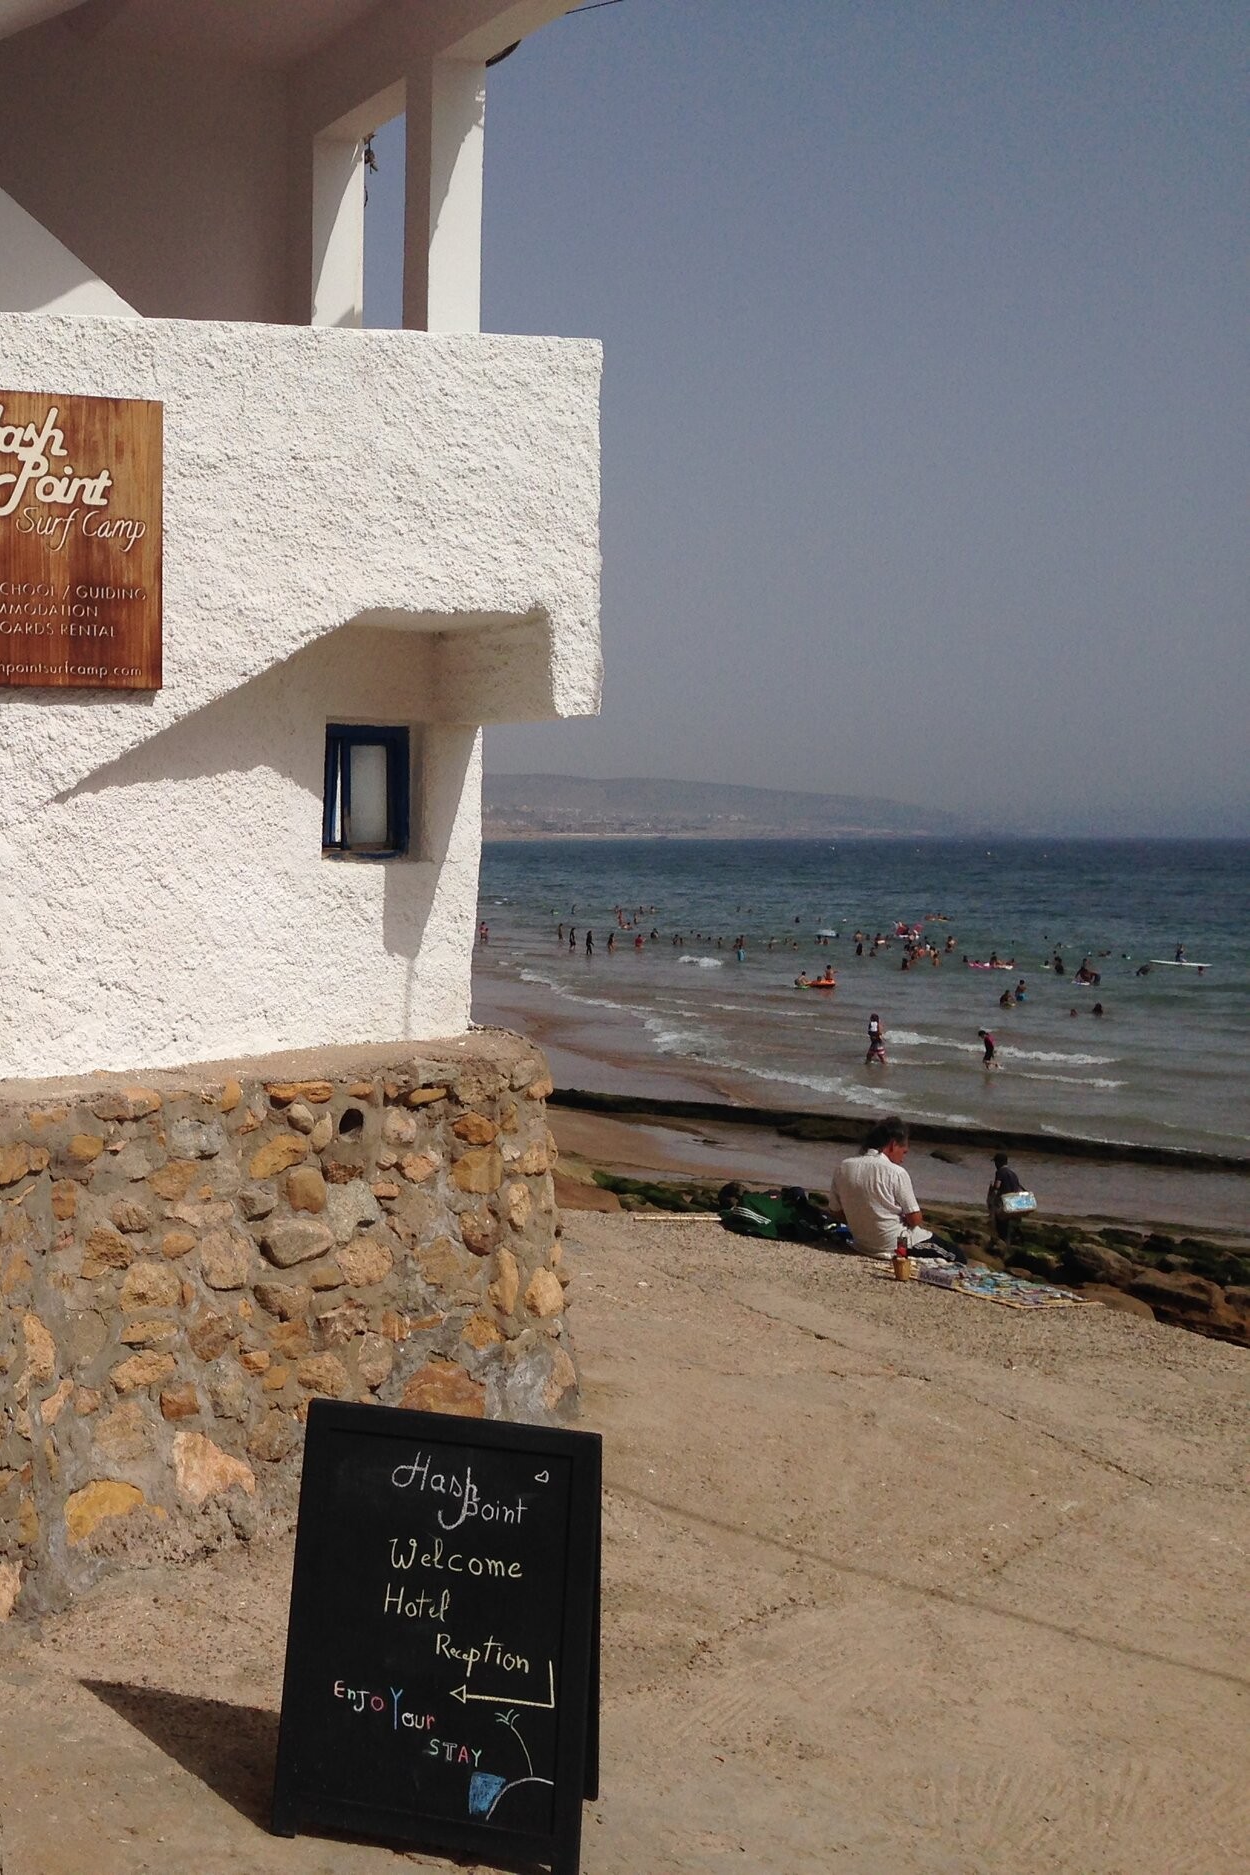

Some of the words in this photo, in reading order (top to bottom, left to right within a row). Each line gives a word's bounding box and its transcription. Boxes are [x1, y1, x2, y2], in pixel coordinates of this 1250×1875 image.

[16, 507, 80, 552] Surf
[82, 510, 146, 552] Camp
[76, 585, 146, 600] GUIDING
[60, 623, 115, 638] RENTAL
[391, 1451, 480, 1502] Hash
[389, 1538, 523, 1578] Welcome
[384, 1582, 451, 1622] Hotel
[435, 1633, 530, 1678] Reception
[429, 1738, 482, 1768] STAY
